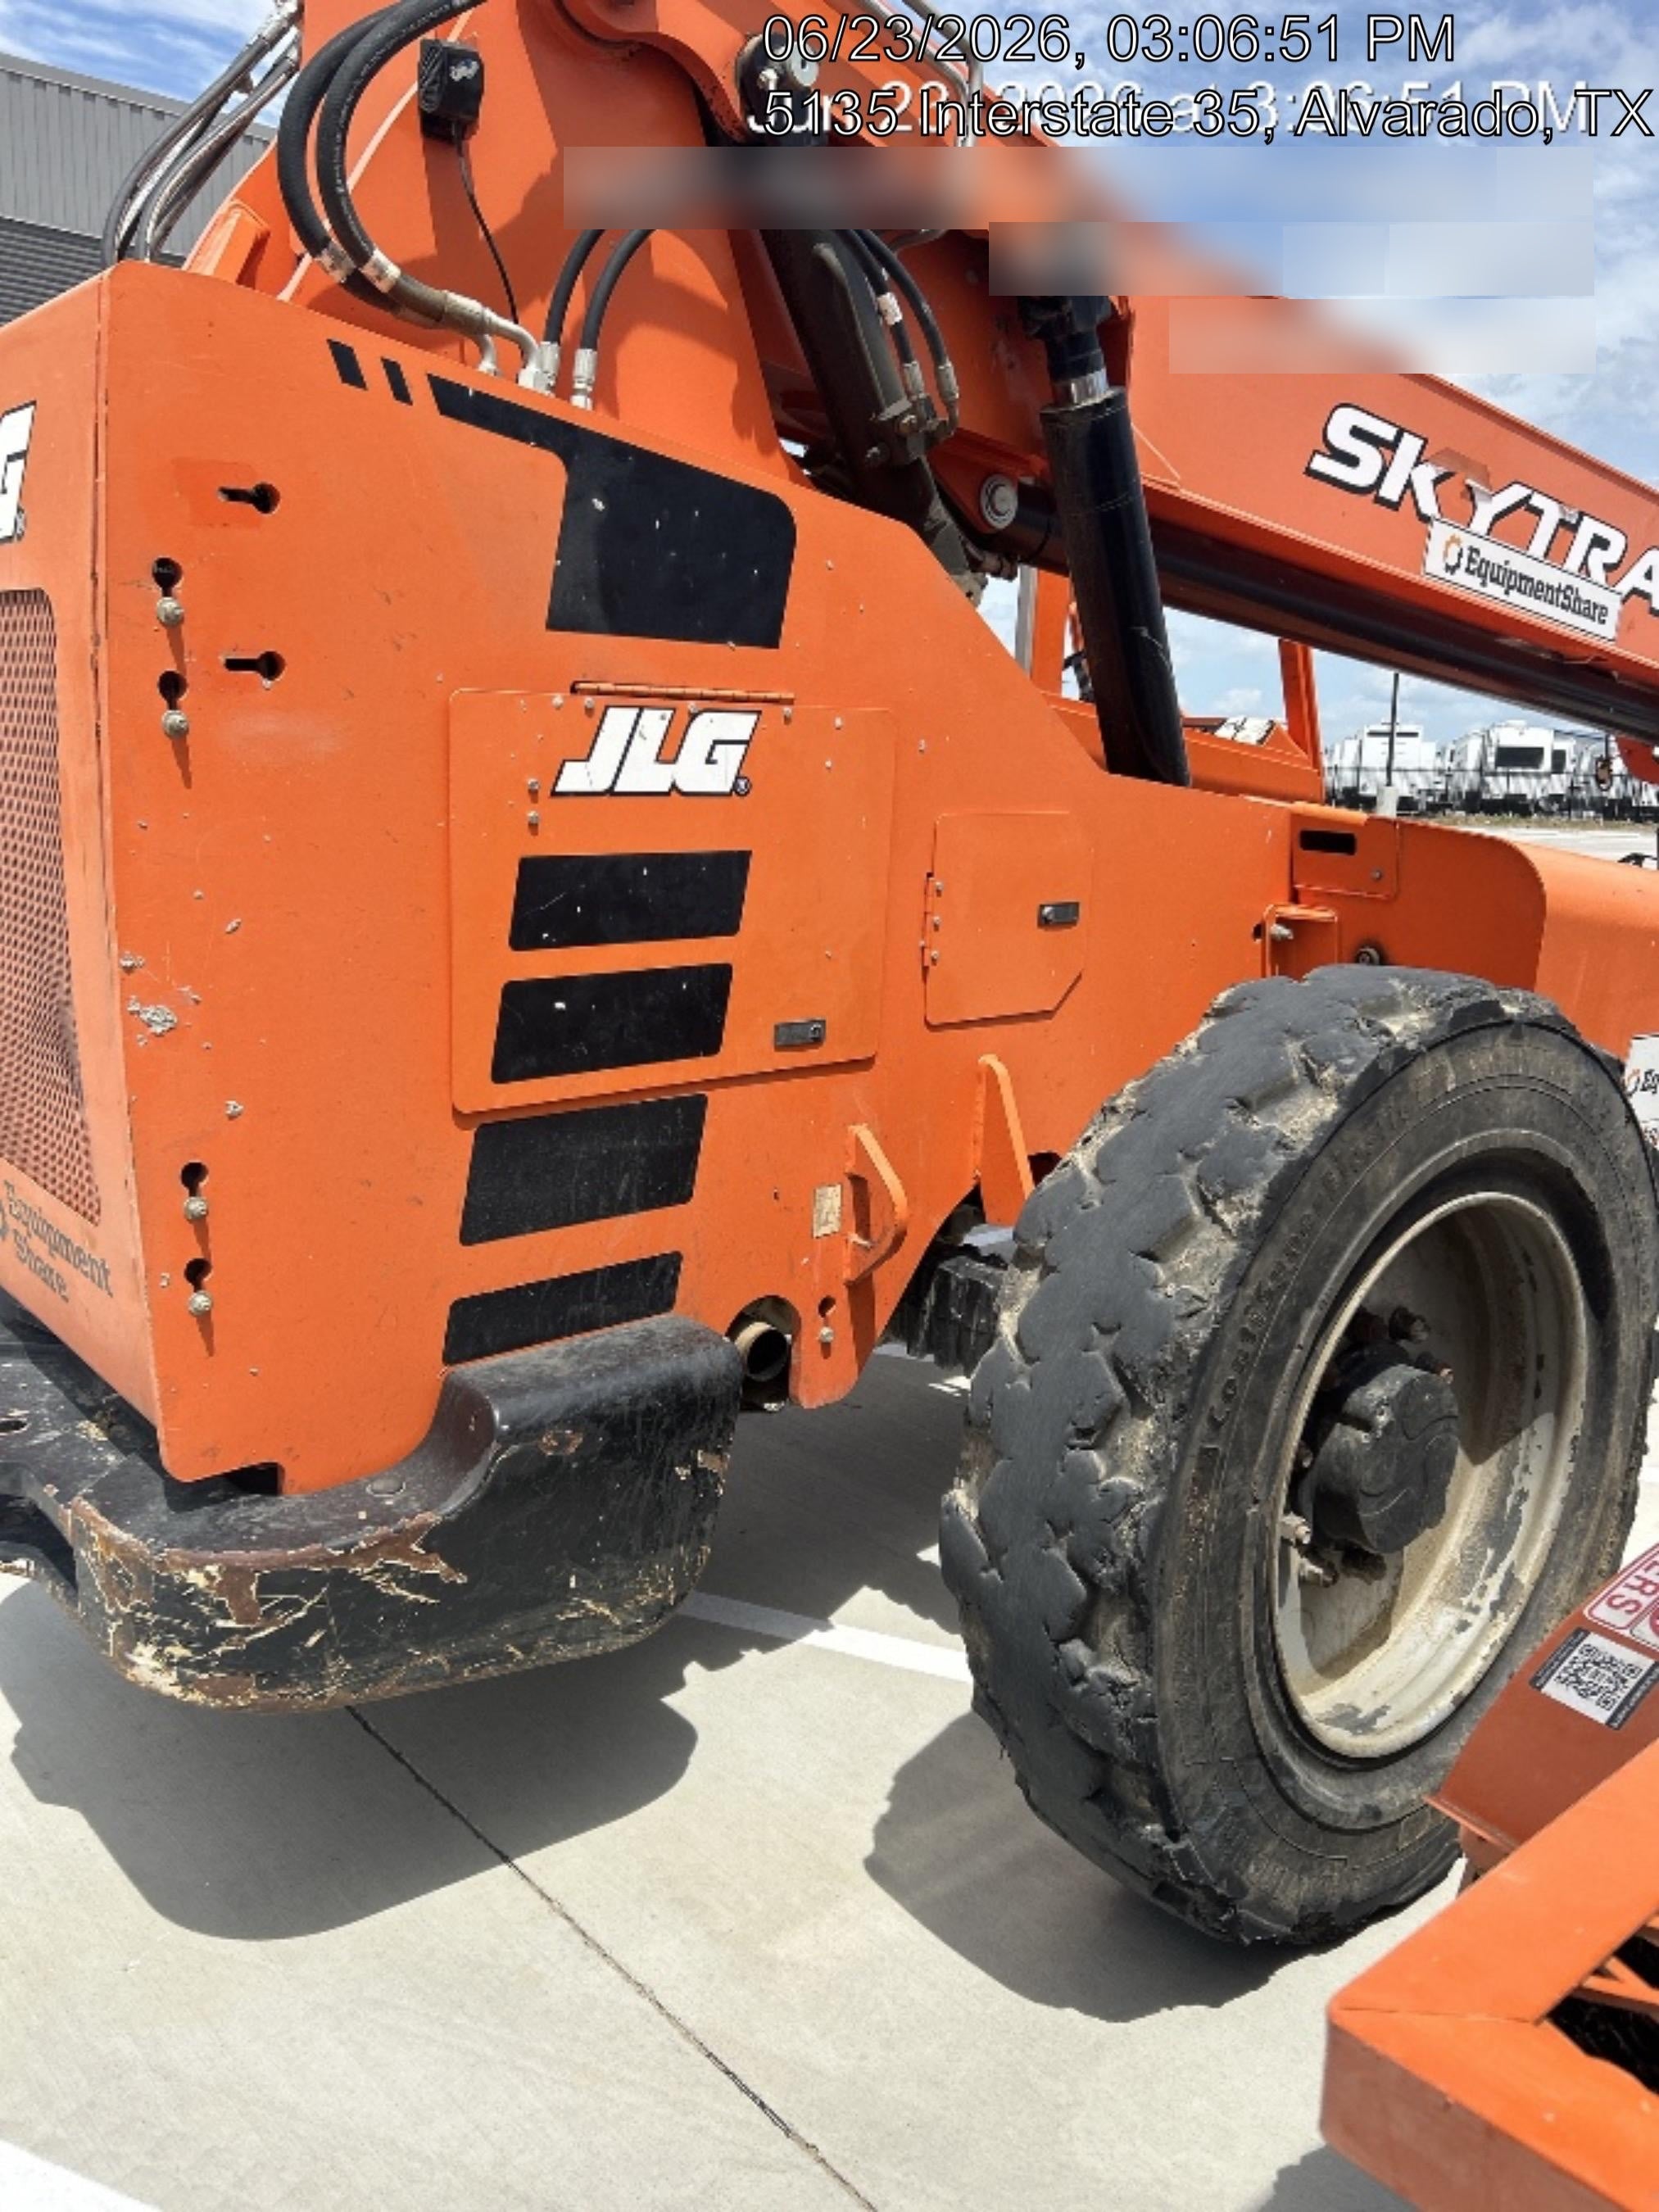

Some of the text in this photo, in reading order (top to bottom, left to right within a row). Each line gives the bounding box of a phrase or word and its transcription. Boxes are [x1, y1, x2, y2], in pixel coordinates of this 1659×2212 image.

[1463, 546, 1610, 626] EquipmentShare
[550, 705, 763, 797] JLG
[3, 1178, 113, 1299] Equipment
[13, 1228, 70, 1303] Share
